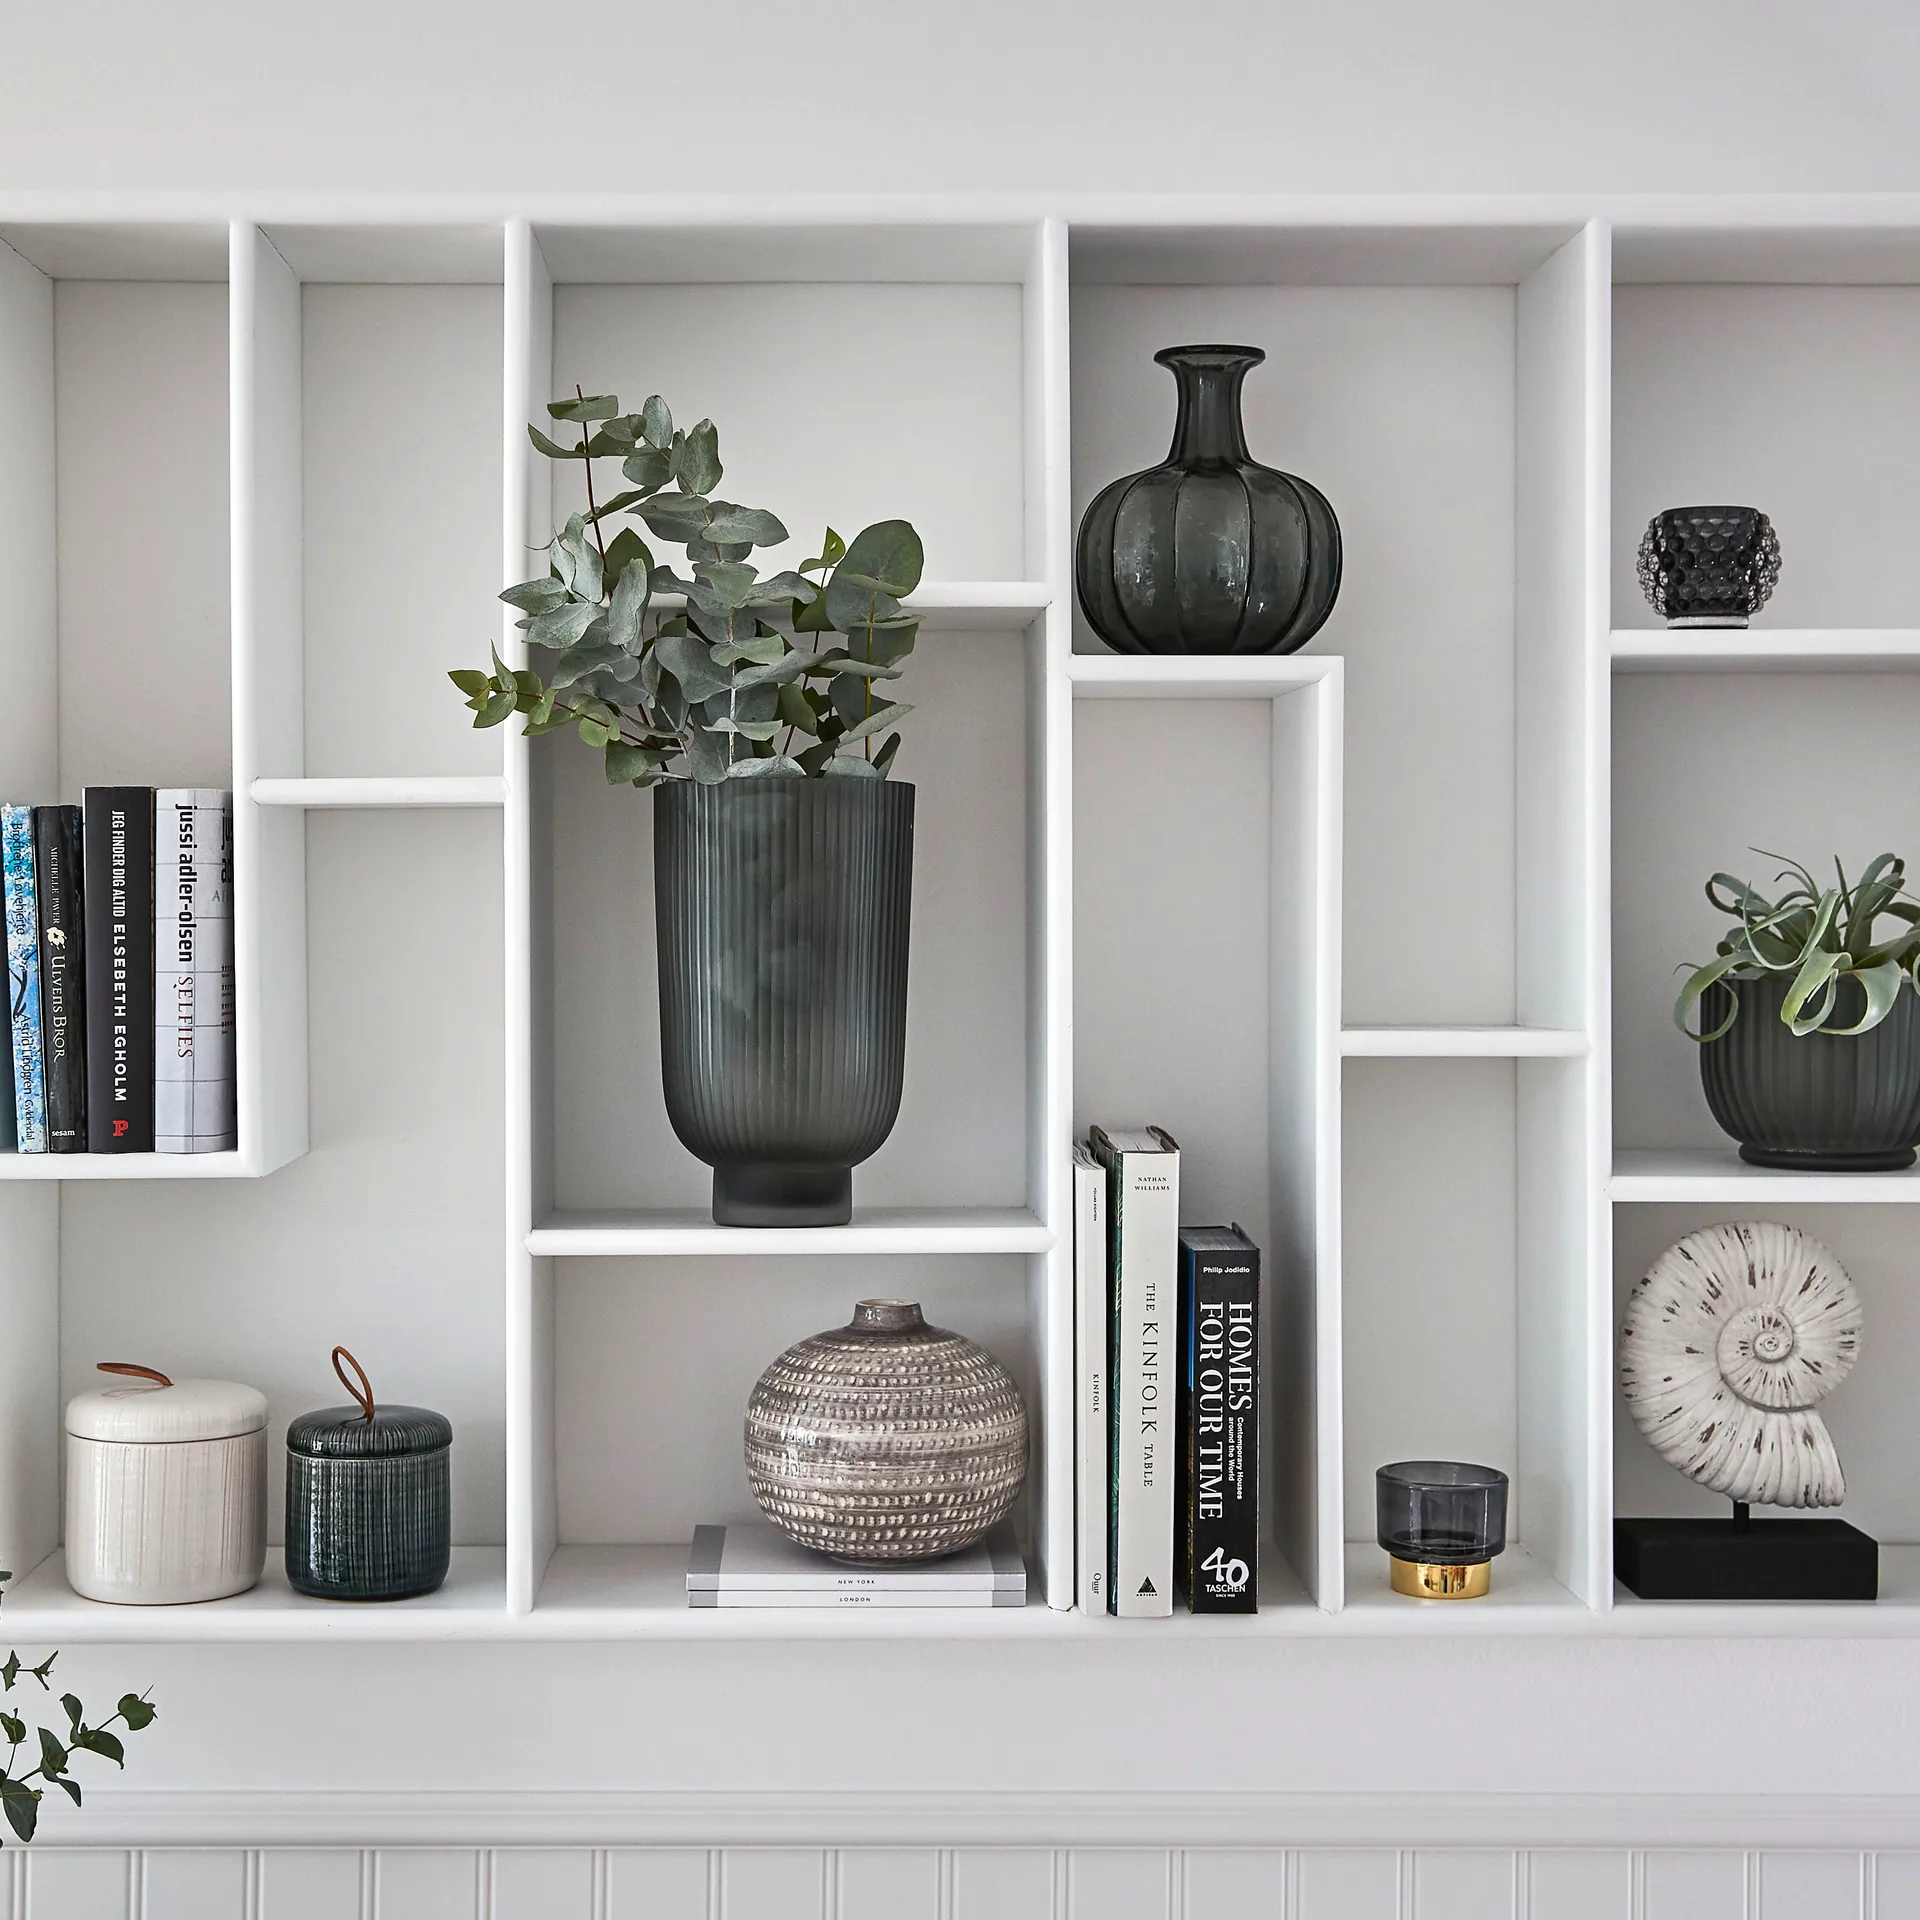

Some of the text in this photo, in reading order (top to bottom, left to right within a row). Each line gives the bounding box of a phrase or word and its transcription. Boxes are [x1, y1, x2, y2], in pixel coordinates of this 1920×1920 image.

[10, 823, 24, 873] Brødrene
[112, 810, 127, 1101] JEG FINDER DIG ALTID ELSEBETH EGHOLM
[175, 804, 198, 1058] jussi adler-olsen SELFIES
[19, 1014, 34, 1095] Astrid Lindgren
[51, 1129, 76, 1137] sesam
[1203, 1266, 1250, 1274] Philip Jodidio
[1141, 1283, 1159, 1487] THE KINFOLK TABLE
[1228, 1301, 1252, 1411] HOMES
[1092, 1373, 1100, 1413] KINFOLK
[1199, 1301, 1224, 1519] FOR OUR TIME
[1236, 1416, 1244, 1500] Contemporary Houses
[1093, 1572, 1102, 1595] Ouur
[1200, 1546, 1250, 1587] 40
[1205, 1584, 1246, 1593] TASCHEN
